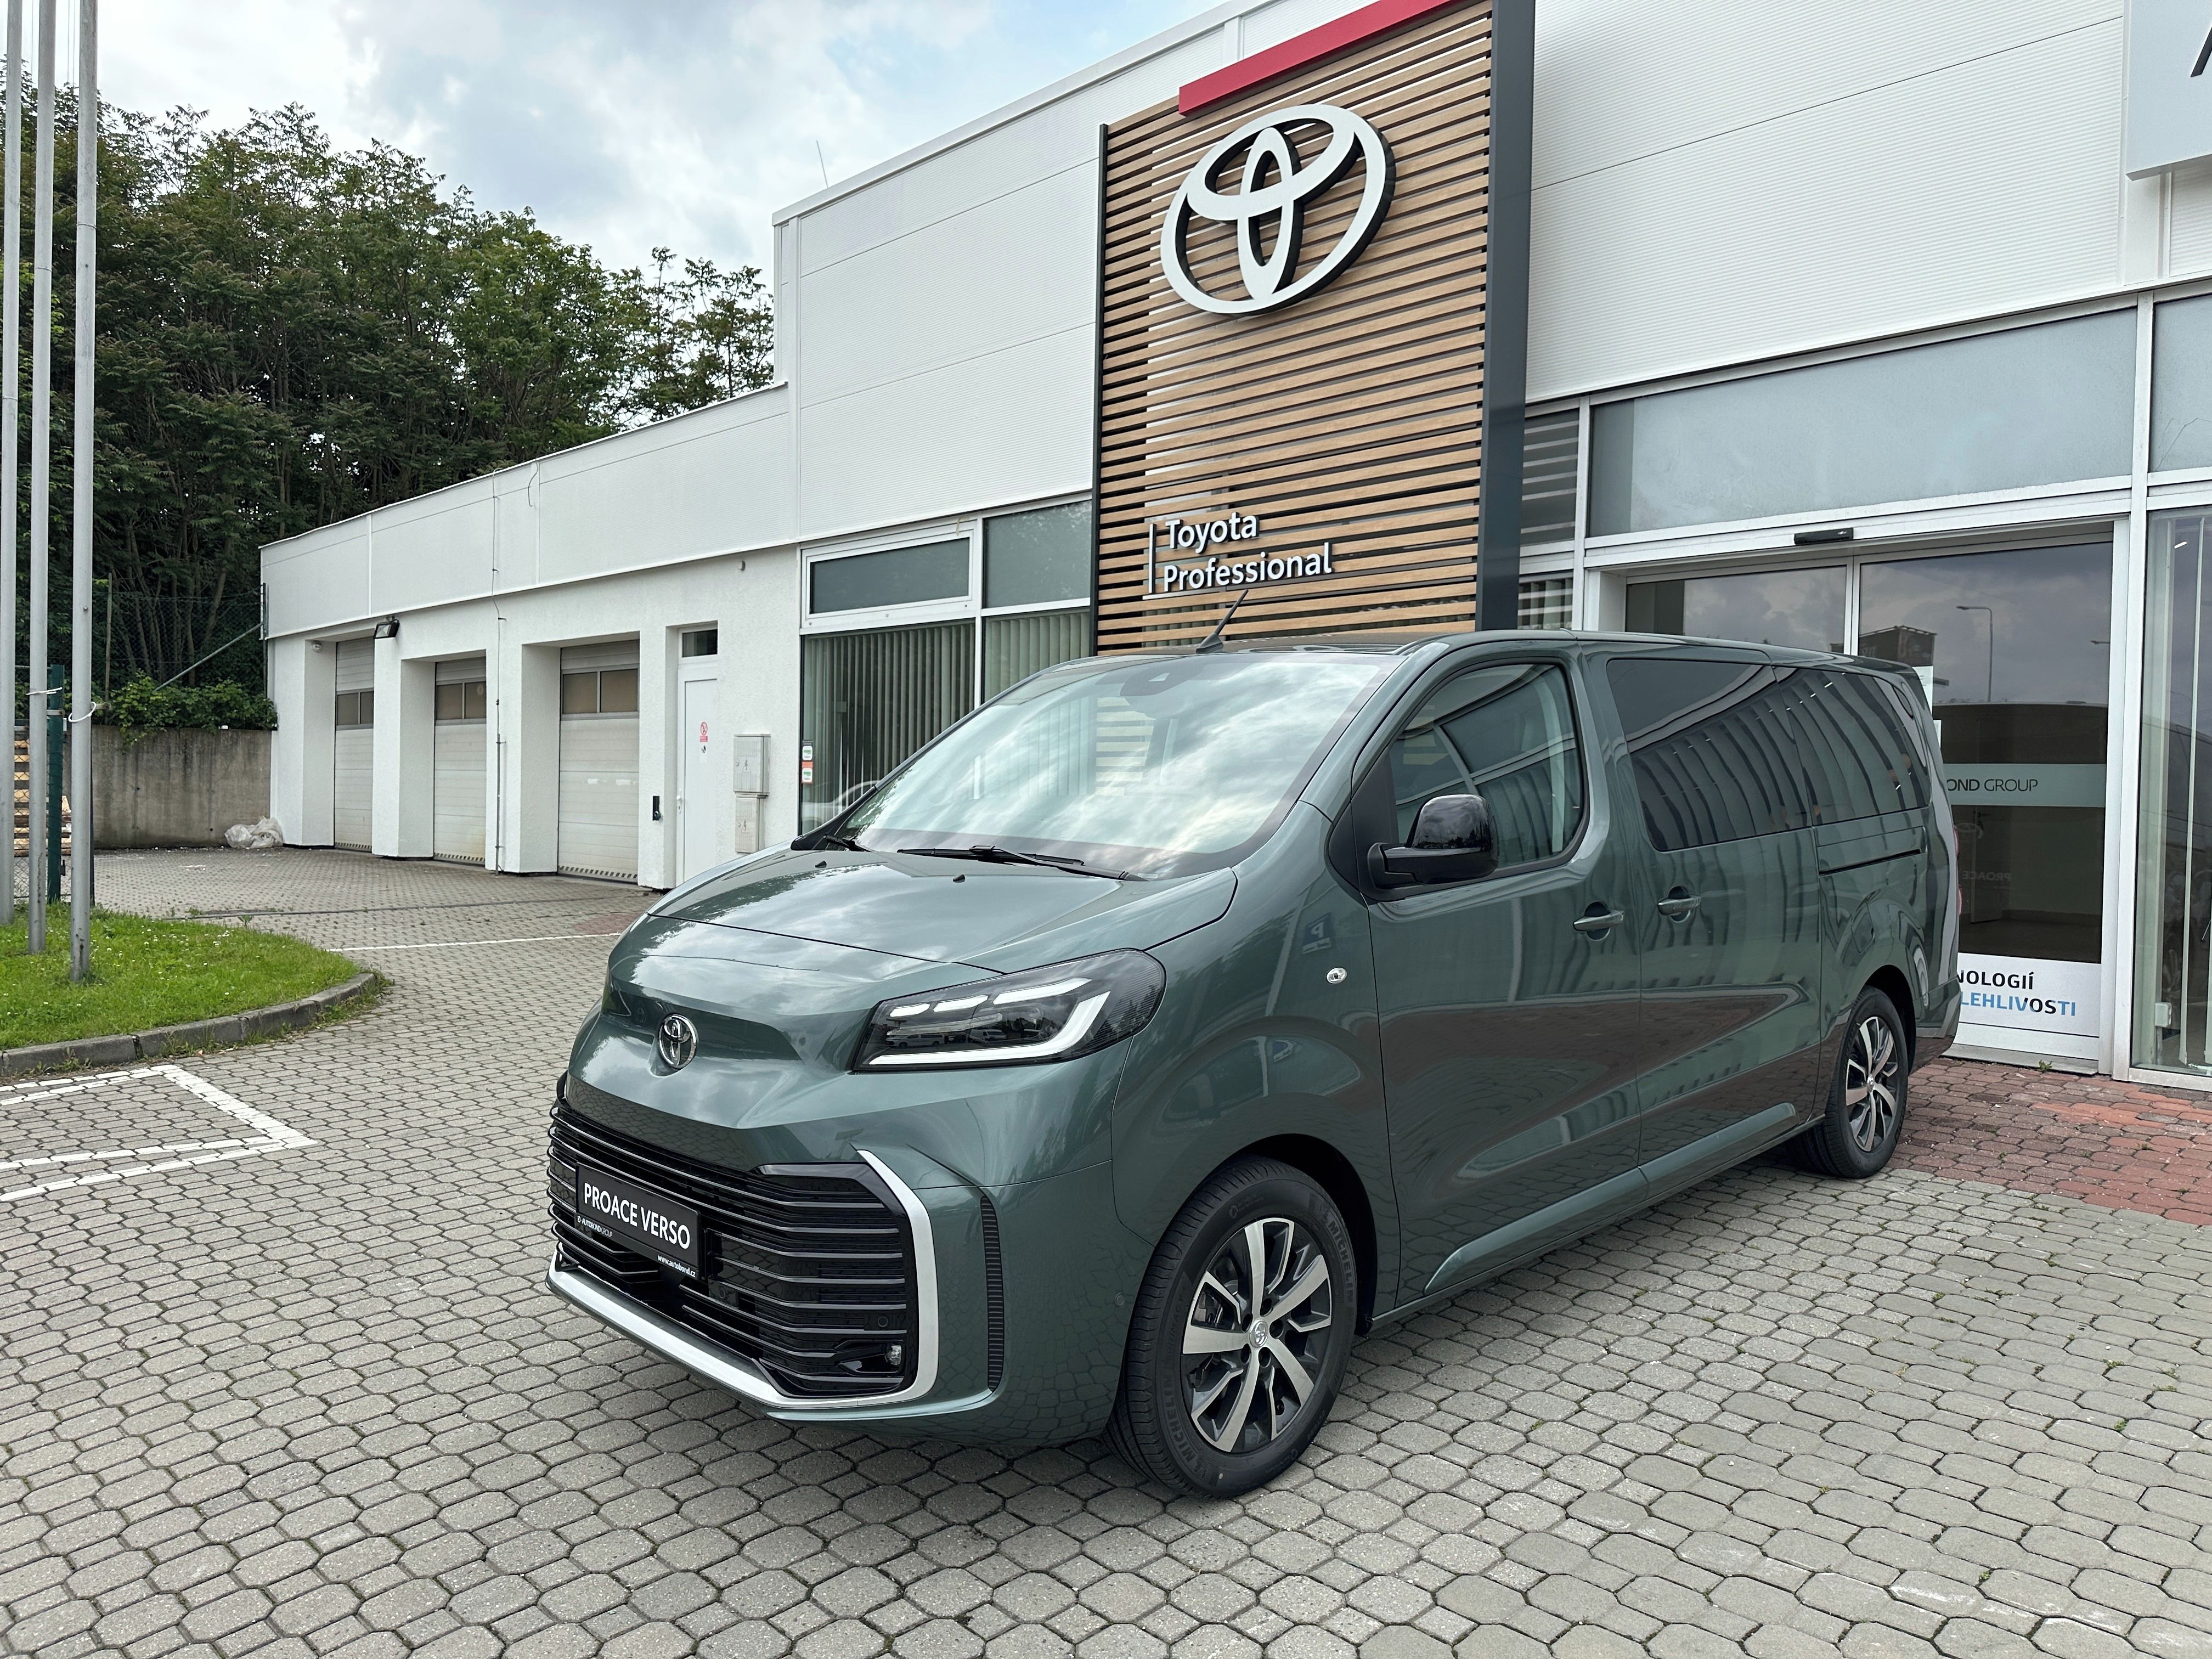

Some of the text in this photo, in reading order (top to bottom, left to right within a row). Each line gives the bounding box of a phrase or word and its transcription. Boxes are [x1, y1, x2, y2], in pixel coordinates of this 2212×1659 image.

[1165, 512, 1259, 554] Toyota
[1164, 542, 1332, 592] Professional
[1946, 778, 2038, 791] OND GROUP
[1961, 991, 2076, 1016] LEHLIVOSTI
[584, 1182, 690, 1249] PROACE VERSO
[1327, 1220, 1354, 1304] MICHELIN
[1163, 1376, 1198, 1463] MICHELIN
